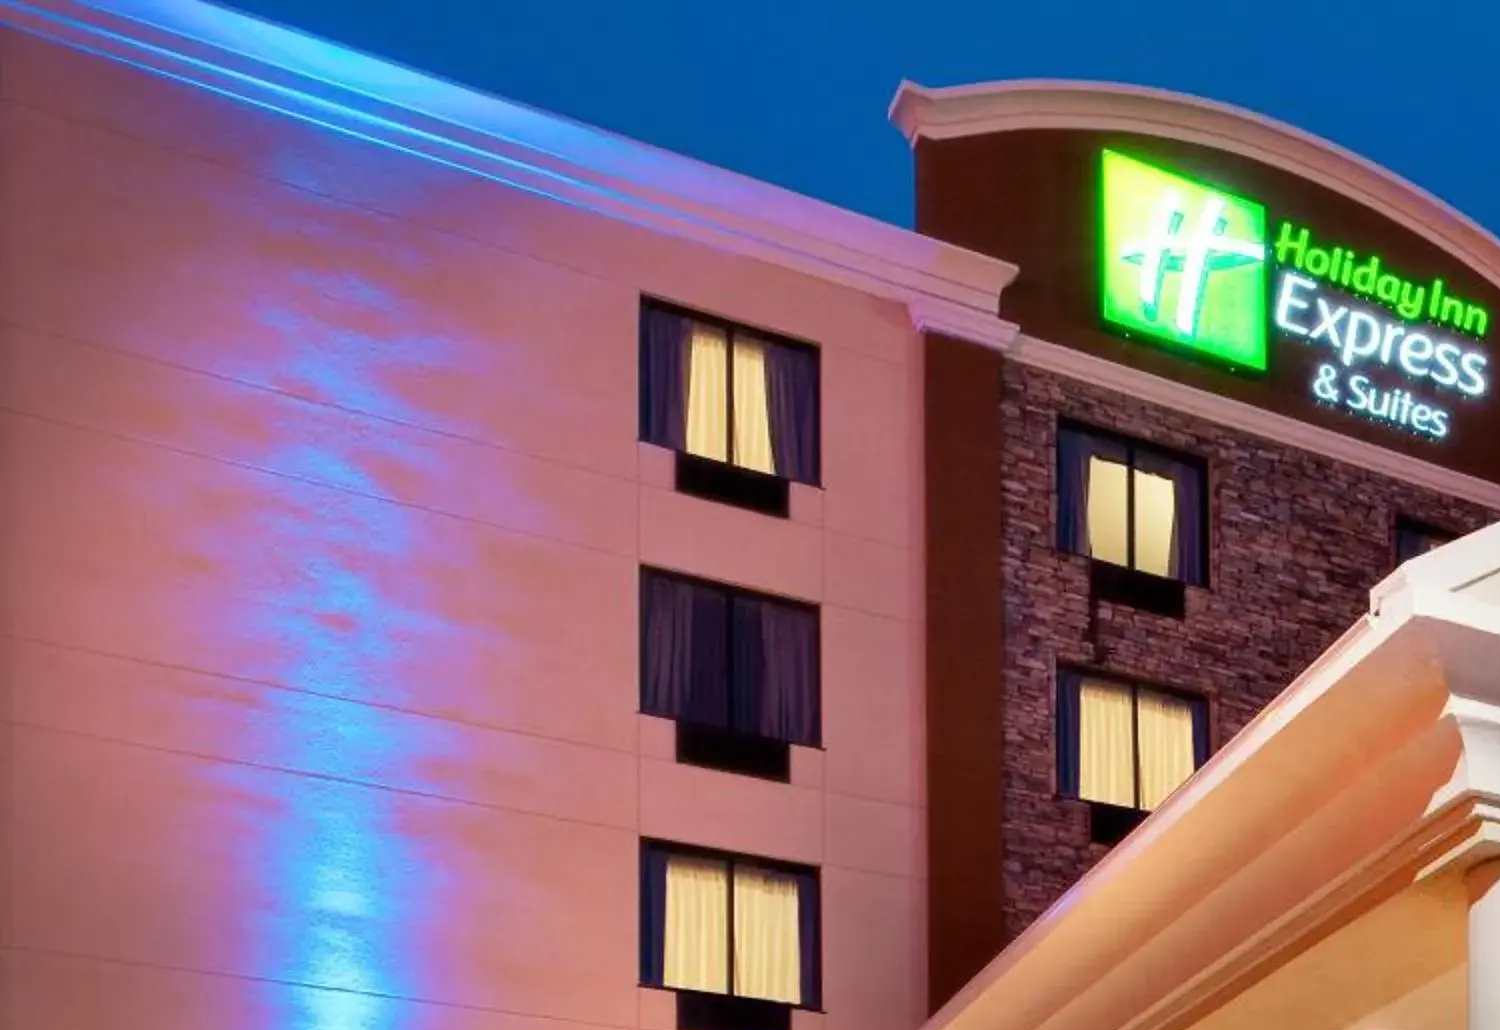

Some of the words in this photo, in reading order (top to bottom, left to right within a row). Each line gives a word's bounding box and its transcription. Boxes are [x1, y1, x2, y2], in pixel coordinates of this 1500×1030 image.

[1274, 272, 1489, 397] Express
[1275, 222, 1424, 320] Holiday
[1430, 281, 1488, 335] Inn
[1313, 364, 1340, 402] &
[1347, 376, 1450, 438] Suites
